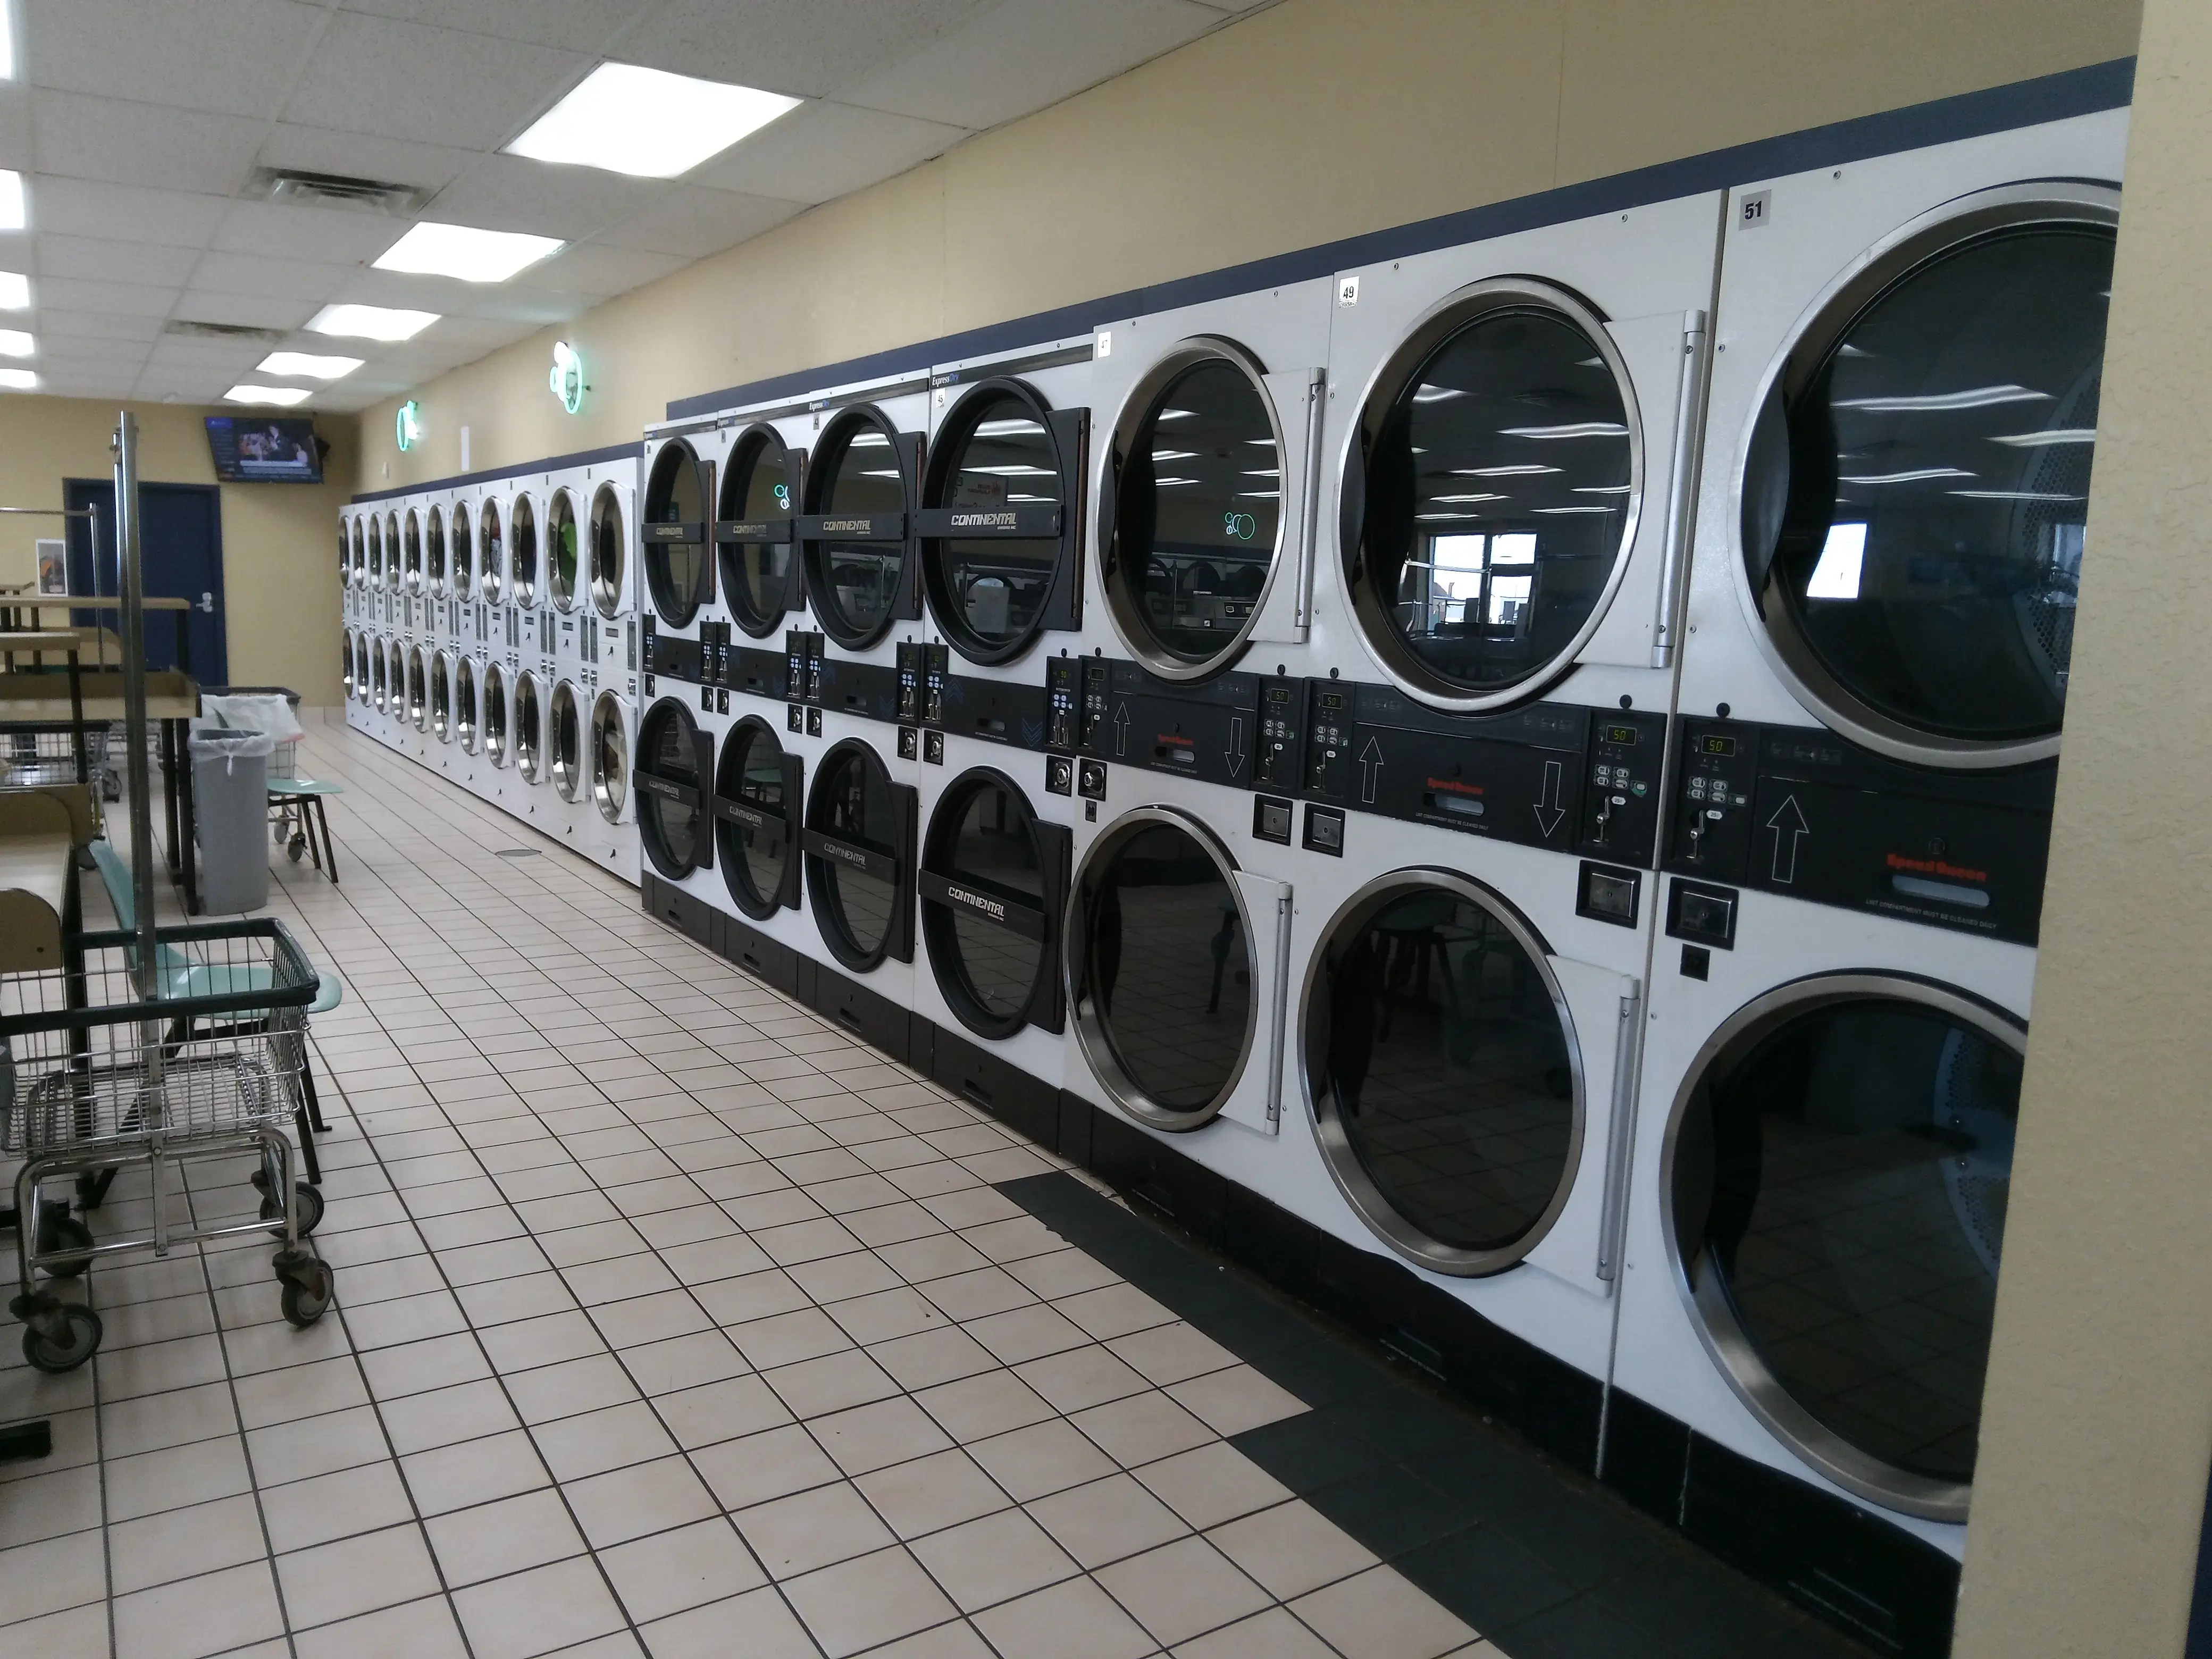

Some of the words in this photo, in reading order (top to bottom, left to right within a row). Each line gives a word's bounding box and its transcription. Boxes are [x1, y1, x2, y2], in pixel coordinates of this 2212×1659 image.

[1745, 200, 1762, 220] 51
[1343, 286, 1354, 299] 49
[823, 520, 871, 531] CONTINENTAL
[951, 513, 1017, 526] CONTINENTAL
[1327, 697, 1336, 706] 50
[1614, 729, 1627, 741] 50
[1710, 740, 1723, 752] 50
[824, 843, 866, 866] CONTINENTAL
[948, 886, 1004, 917] CONTINENTAL
